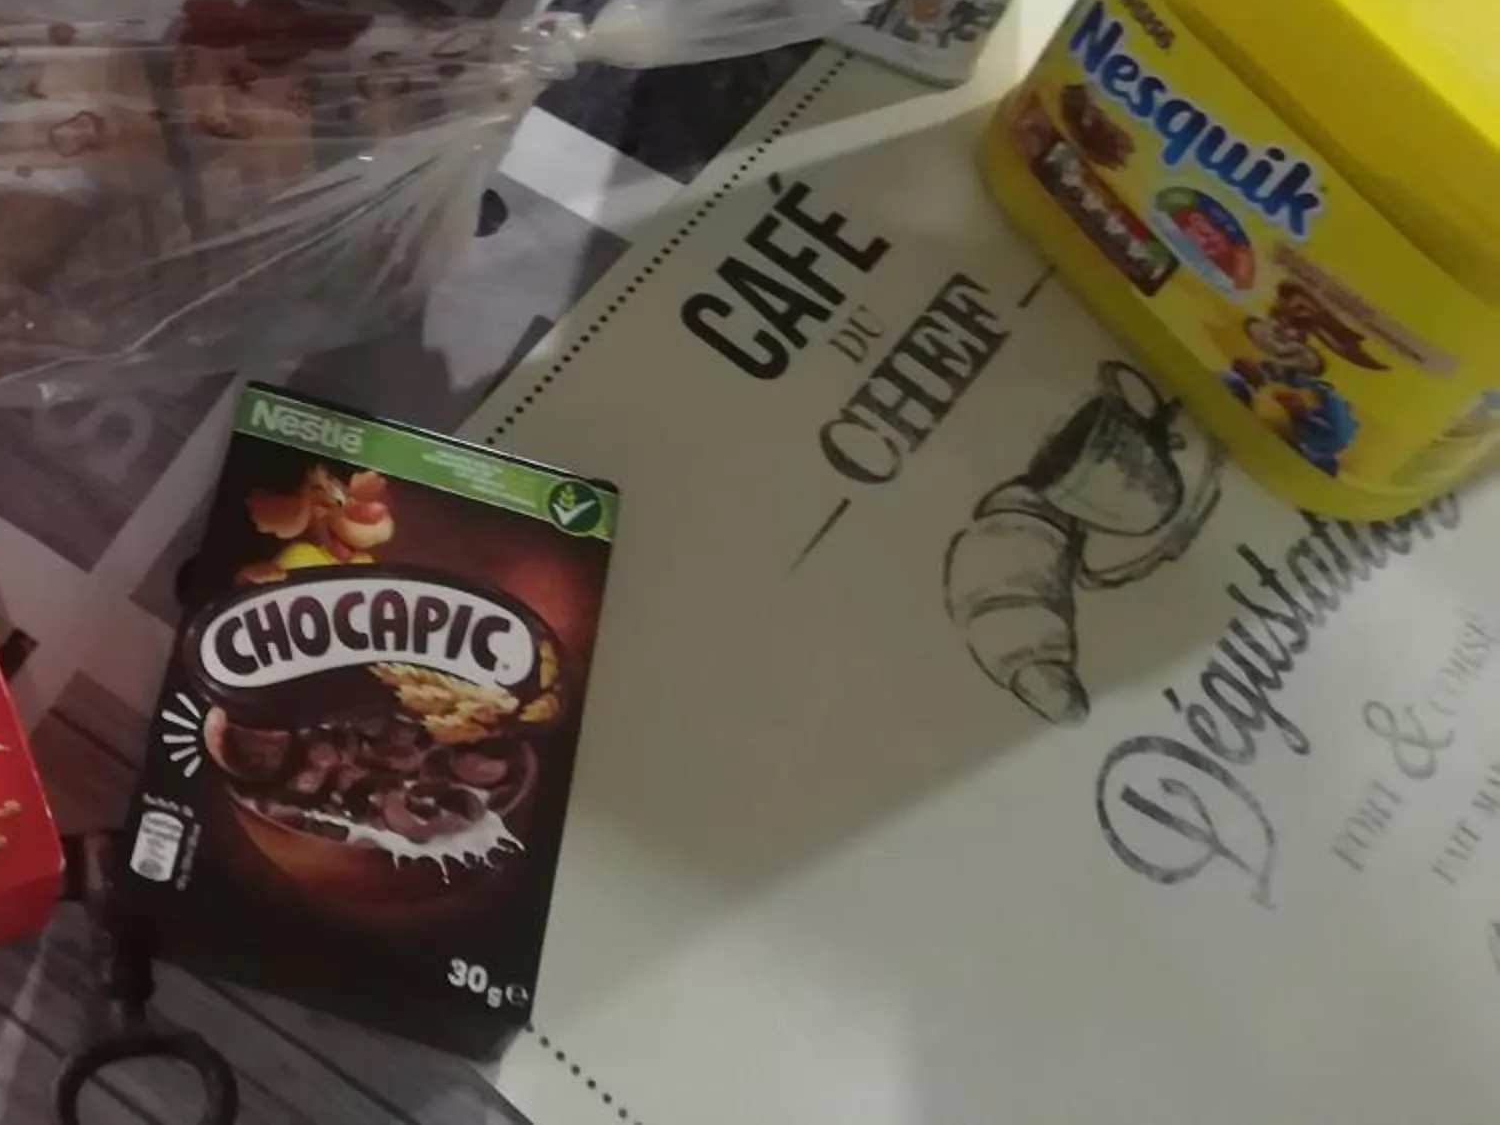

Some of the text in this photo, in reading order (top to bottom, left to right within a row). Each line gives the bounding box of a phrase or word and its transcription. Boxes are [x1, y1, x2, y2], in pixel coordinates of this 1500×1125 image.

[679, 171, 892, 380] CAFÉ
[828, 304, 885, 365] DU
[818, 272, 1012, 485] CHEF
[213, 589, 510, 673] CHOCAPIC
[1362, 698, 1456, 781] &
